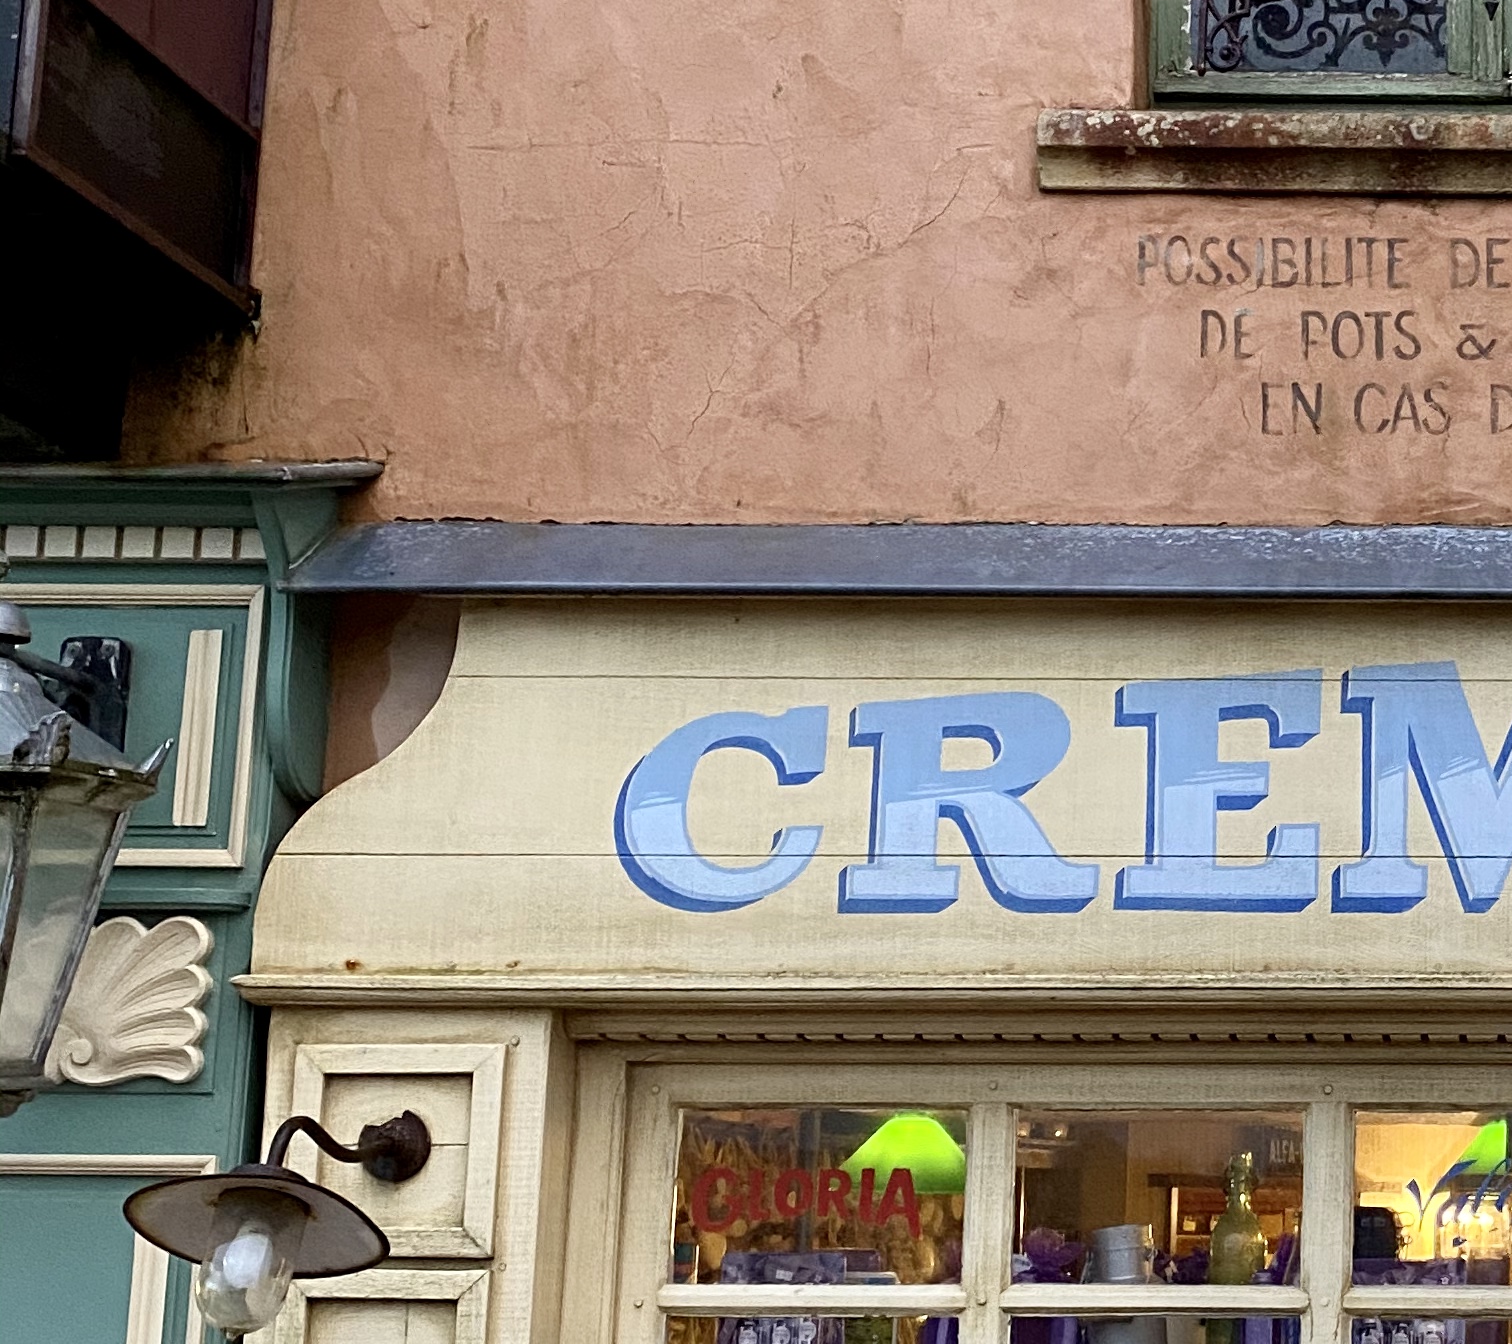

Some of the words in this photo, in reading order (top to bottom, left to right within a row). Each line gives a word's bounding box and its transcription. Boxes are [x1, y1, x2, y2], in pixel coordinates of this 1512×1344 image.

[1136, 234, 1411, 290] POSSIBILITE
[1450, 238, 1512, 289] DE
[1199, 309, 1254, 360] DE
[1300, 310, 1422, 361] POTS
[1456, 320, 1497, 361] &
[1260, 382, 1325, 436] EN
[1353, 380, 1452, 436] CAS
[691, 1167, 922, 1240] GLORIA
